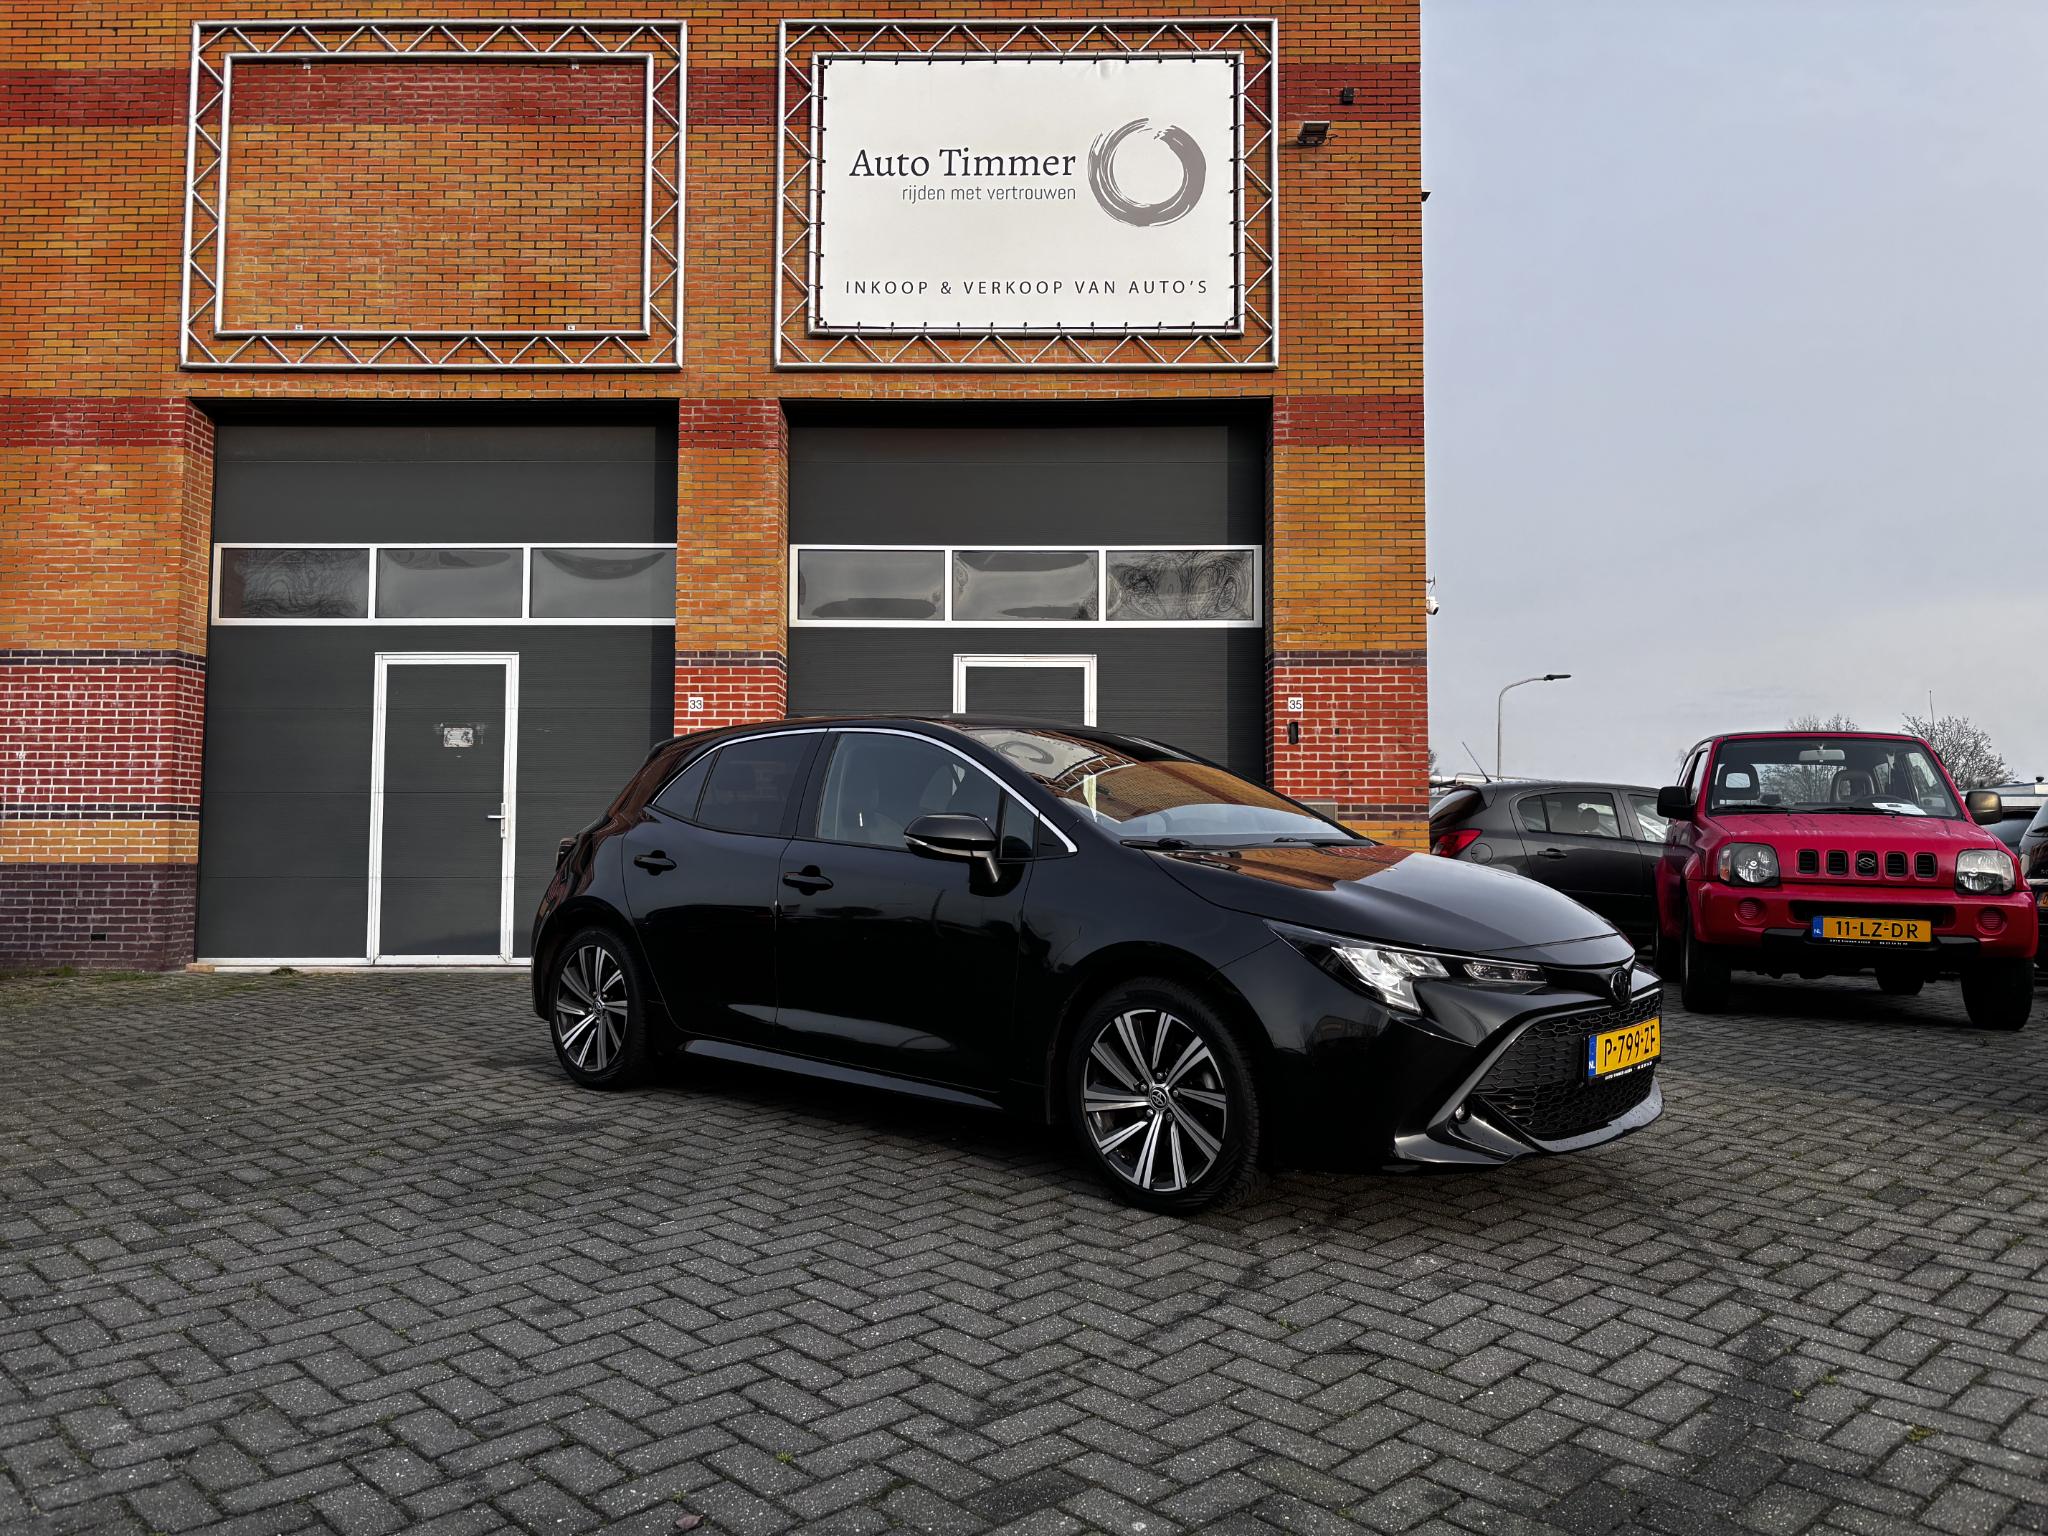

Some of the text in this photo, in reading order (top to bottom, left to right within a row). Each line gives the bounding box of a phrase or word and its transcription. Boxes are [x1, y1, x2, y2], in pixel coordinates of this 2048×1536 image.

[848, 147, 1076, 177] Auto Timmer
[902, 184, 1076, 204] rijden met vertrouwen
[845, 280, 928, 295] INKOOP
[940, 281, 952, 295] &
[963, 281, 1063, 295] VERKOOP
[1074, 280, 1115, 294] VAN
[689, 699, 703, 710] 33
[1289, 699, 1303, 710] 35
[1835, 920, 1919, 939] 11-LZ-DR
[1588, 1024, 1656, 1070] NL P-799-ZF
